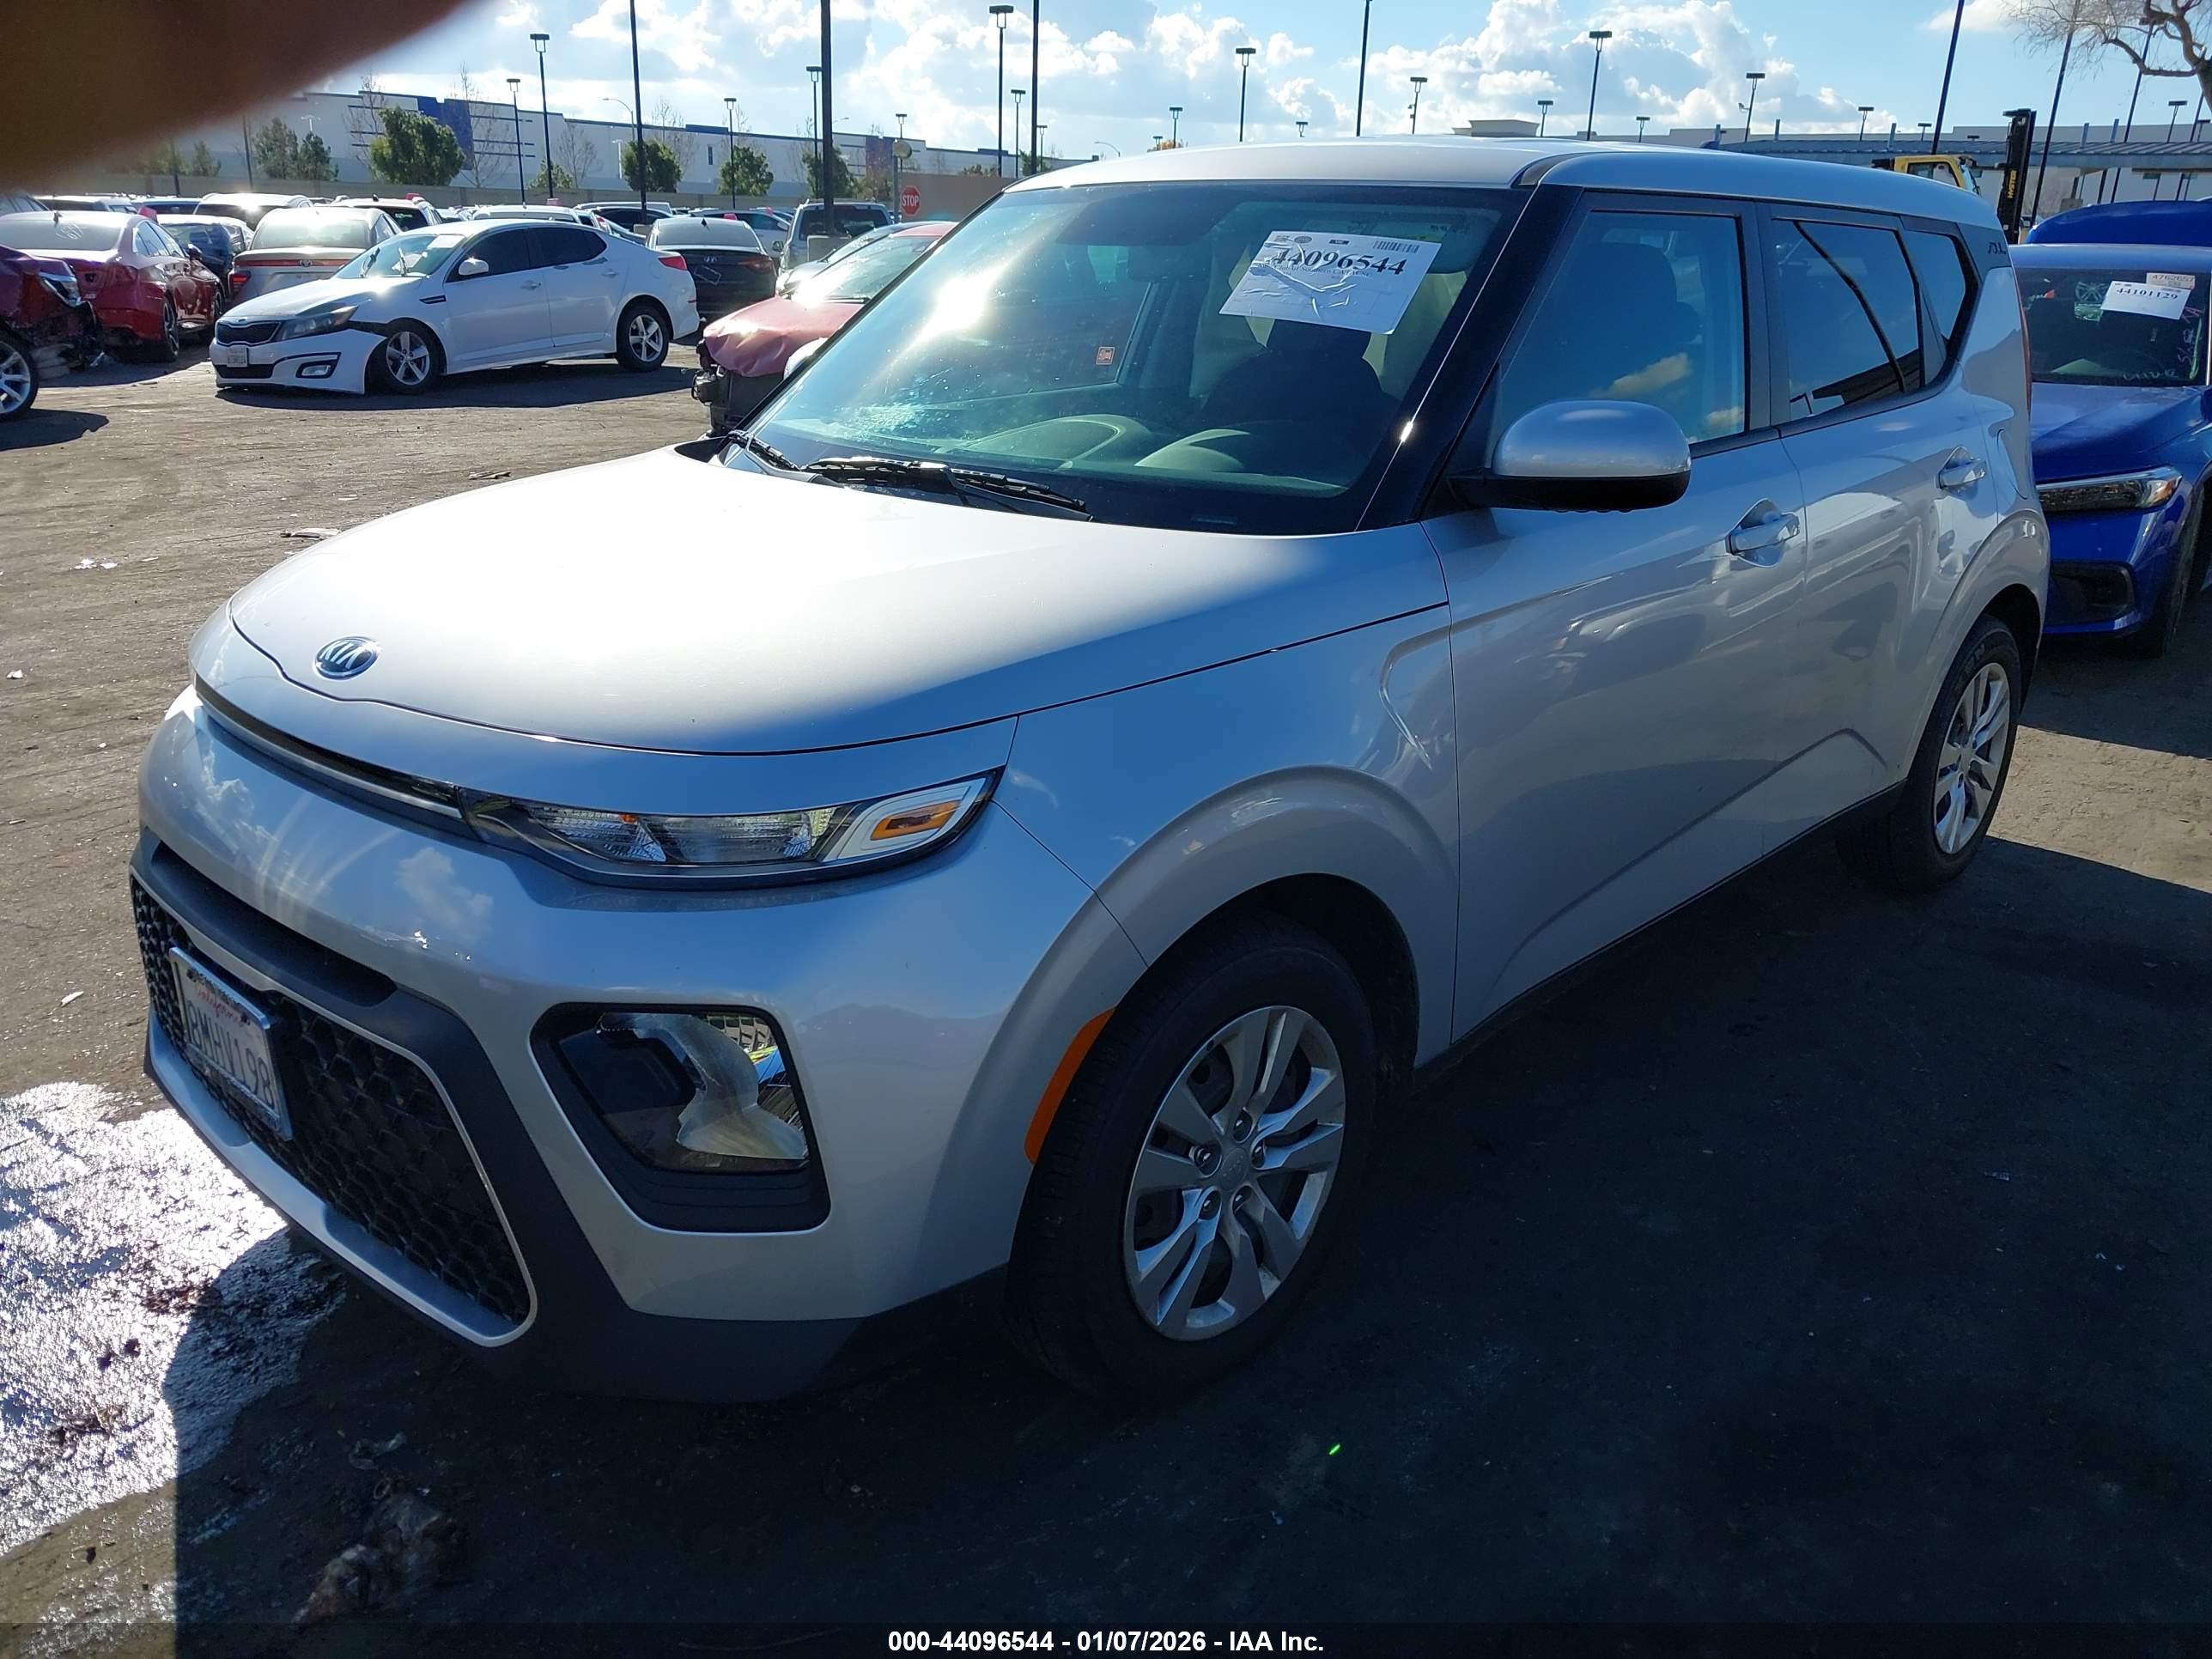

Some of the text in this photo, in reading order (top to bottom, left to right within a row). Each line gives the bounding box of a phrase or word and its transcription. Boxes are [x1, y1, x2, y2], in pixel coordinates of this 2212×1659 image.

[902, 195, 920, 207] STOP
[1271, 249, 1408, 276] 44096544
[2116, 288, 2179, 301] 44101129
